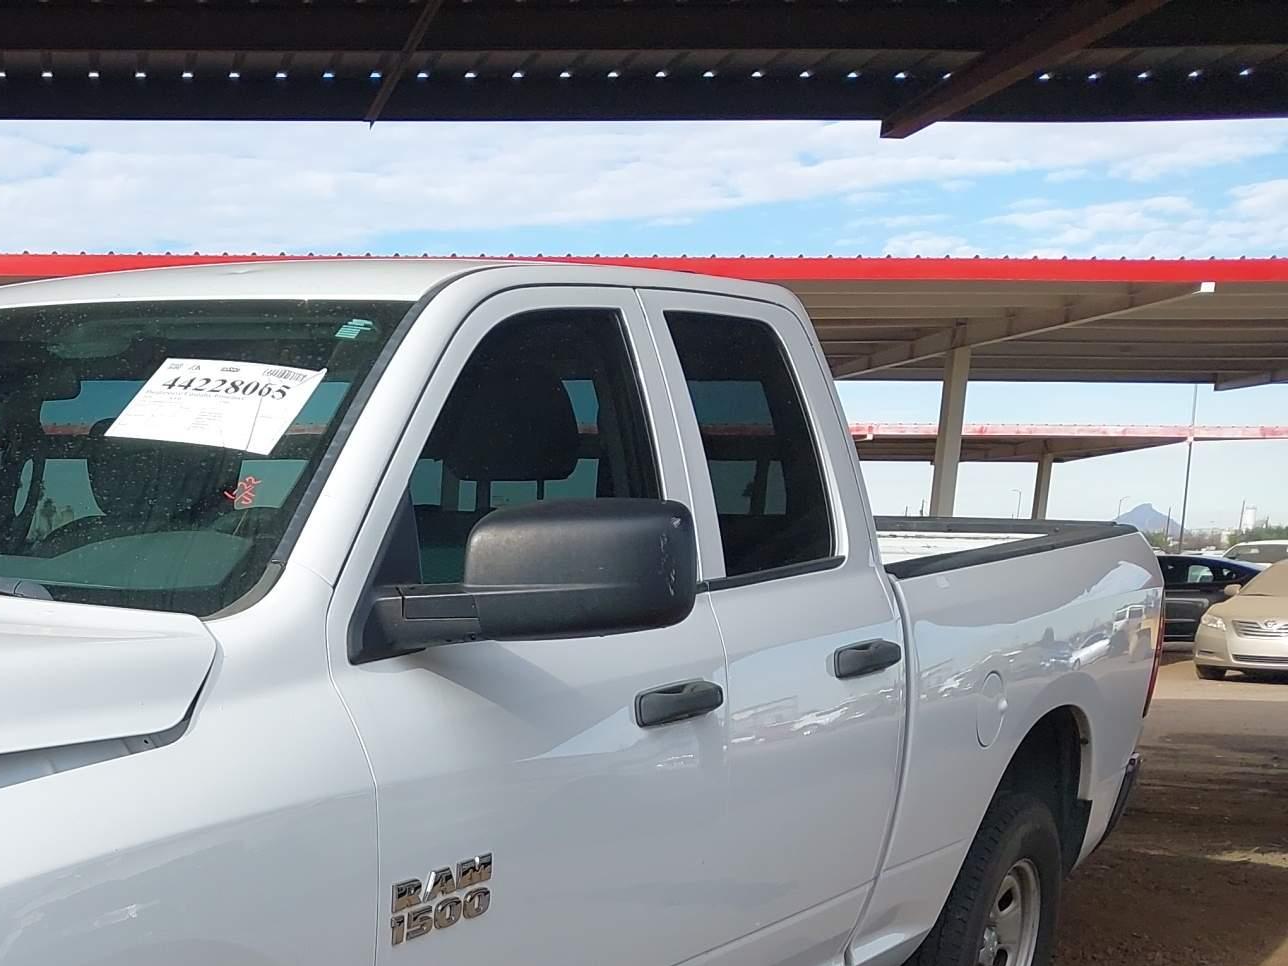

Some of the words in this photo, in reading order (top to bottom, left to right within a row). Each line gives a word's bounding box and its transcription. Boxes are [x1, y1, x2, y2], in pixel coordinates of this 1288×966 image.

[161, 375, 291, 401] 44228065
[391, 852, 493, 913] RAM
[391, 887, 491, 947] 1500
